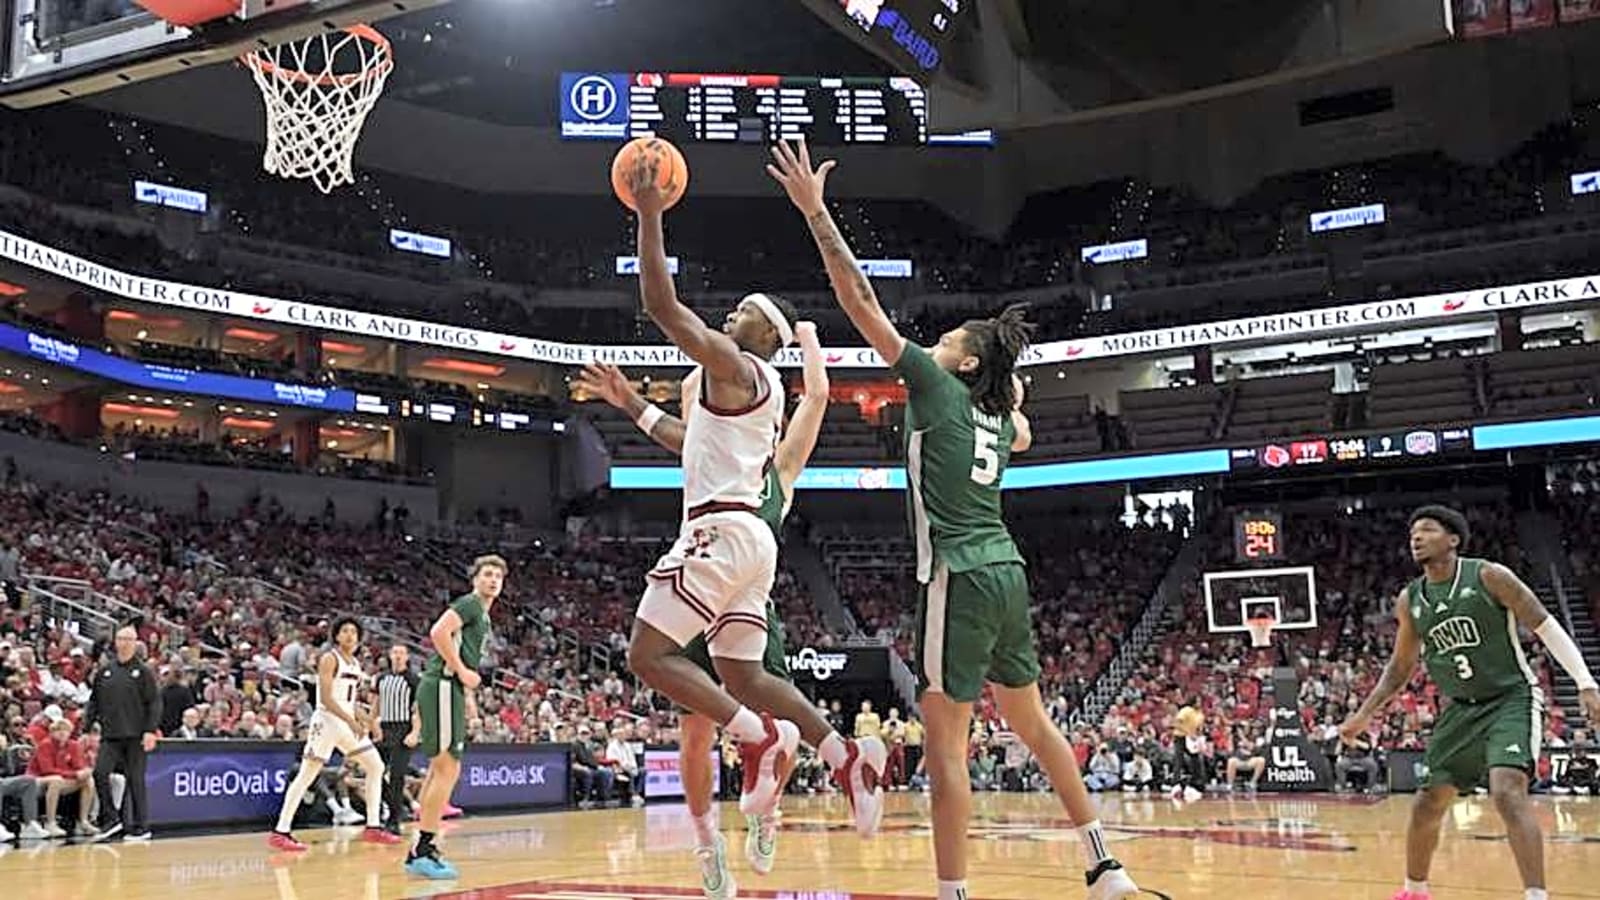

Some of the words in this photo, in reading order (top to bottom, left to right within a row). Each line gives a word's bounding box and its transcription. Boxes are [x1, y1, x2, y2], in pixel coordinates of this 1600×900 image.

[1483, 282, 1570, 307] CLARK
[287, 304, 358, 329] CLARK
[366, 317, 411, 337] AND
[420, 325, 479, 347] RIGGS
[1102, 301, 1416, 352] MORETHANAPRINTER.COM
[1301, 444, 1319, 458] 17
[1330, 438, 1366, 454] 13:06
[1380, 437, 1392, 451] 9
[970, 426, 999, 486] 5
[1245, 520, 1276, 535] 13:06
[1246, 535, 1274, 557] 24
[791, 647, 847, 681] Kroger
[1453, 654, 1474, 680] 3
[1271, 746, 1308, 767] UL
[174, 768, 269, 797] BlueOval
[275, 770, 287, 793] S
[470, 765, 527, 787] BlueOval
[530, 767, 546, 785] SK
[1267, 766, 1317, 782] Health
